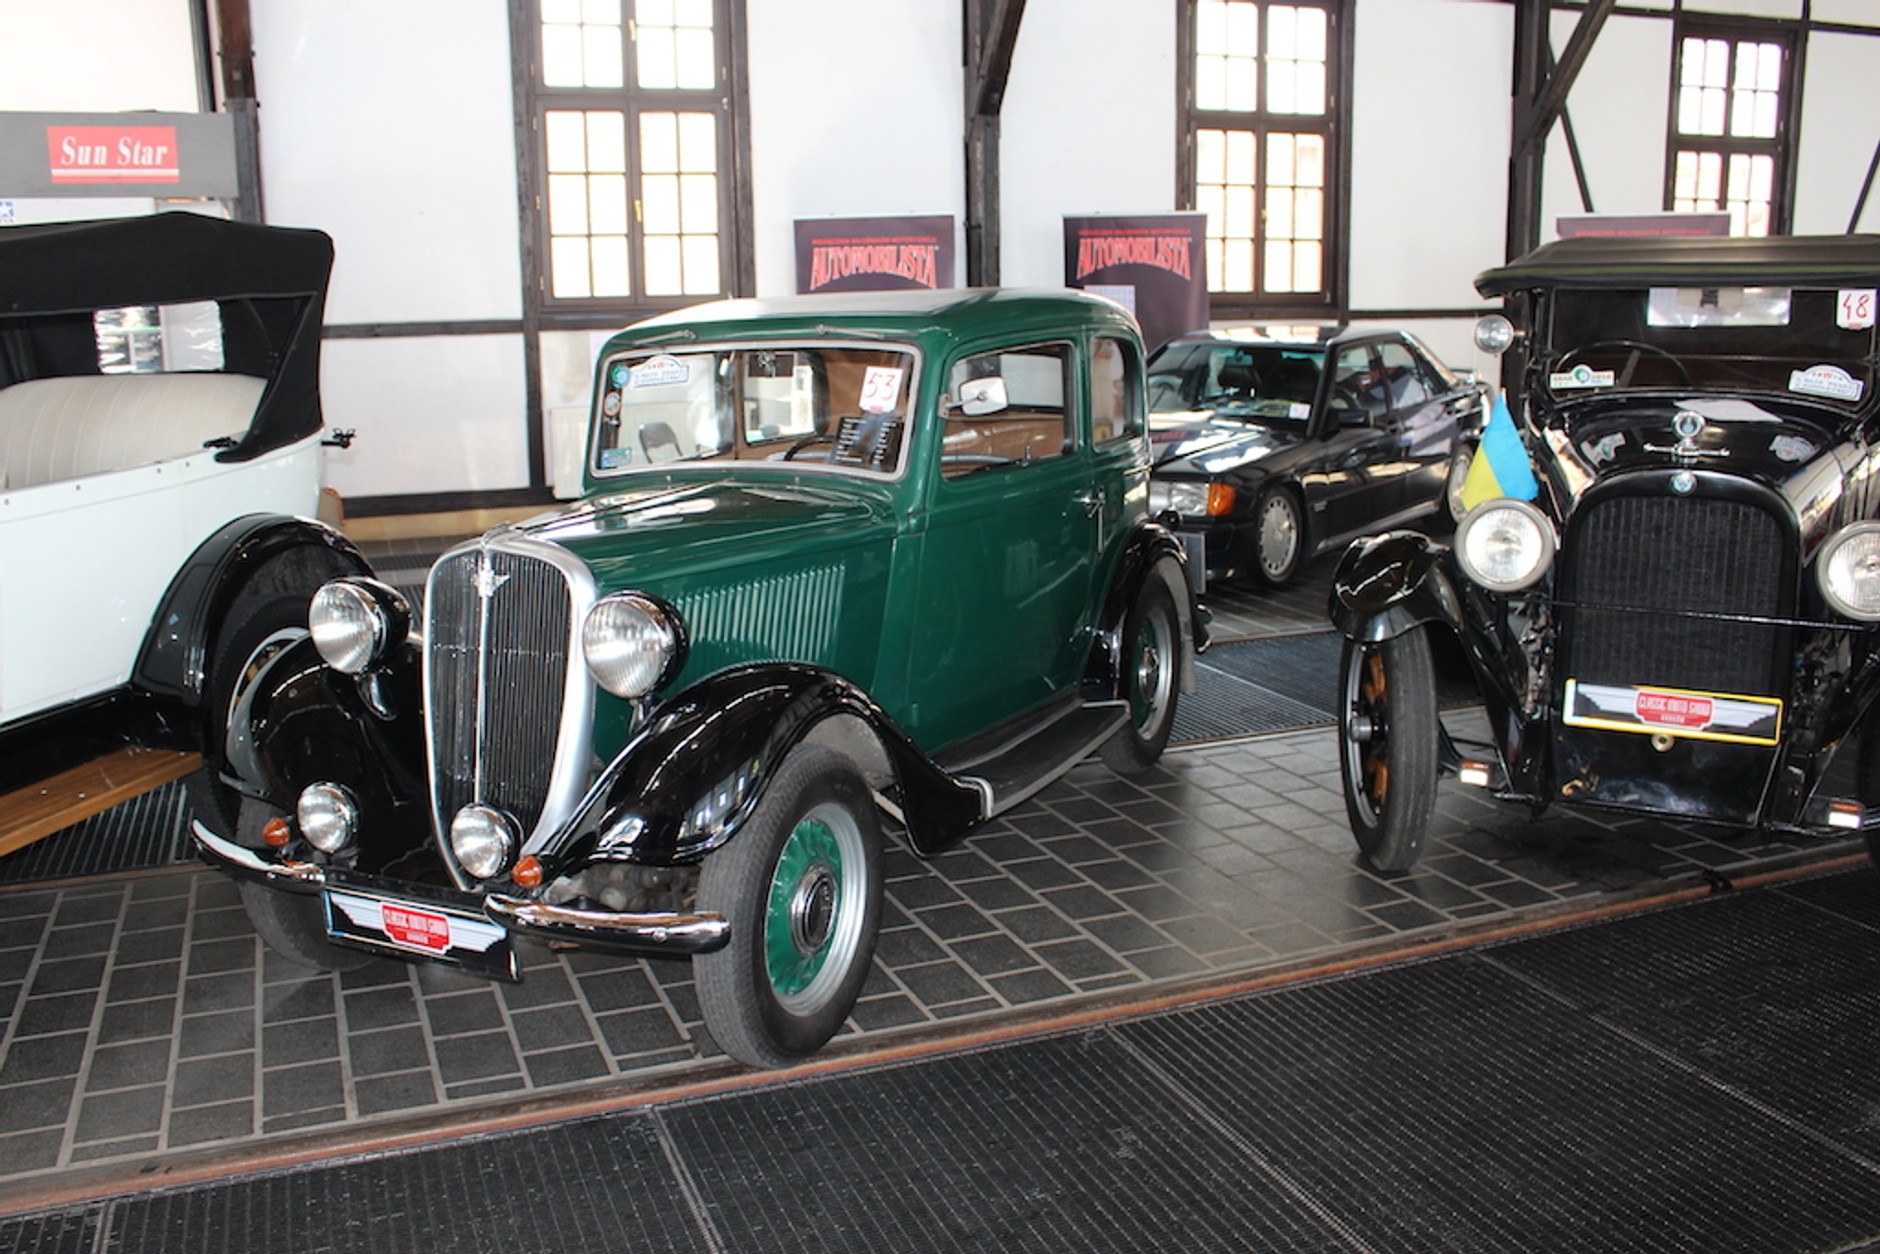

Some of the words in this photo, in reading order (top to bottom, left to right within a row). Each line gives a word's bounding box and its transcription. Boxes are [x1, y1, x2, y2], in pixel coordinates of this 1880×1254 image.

[61, 136, 107, 165] Sun
[117, 136, 168, 166] Star
[810, 245, 937, 290] AUTOMOBILISTA
[1076, 237, 1191, 280] AUTOMOBILISTA
[1843, 293, 1870, 320] 48
[863, 372, 896, 401] 53
